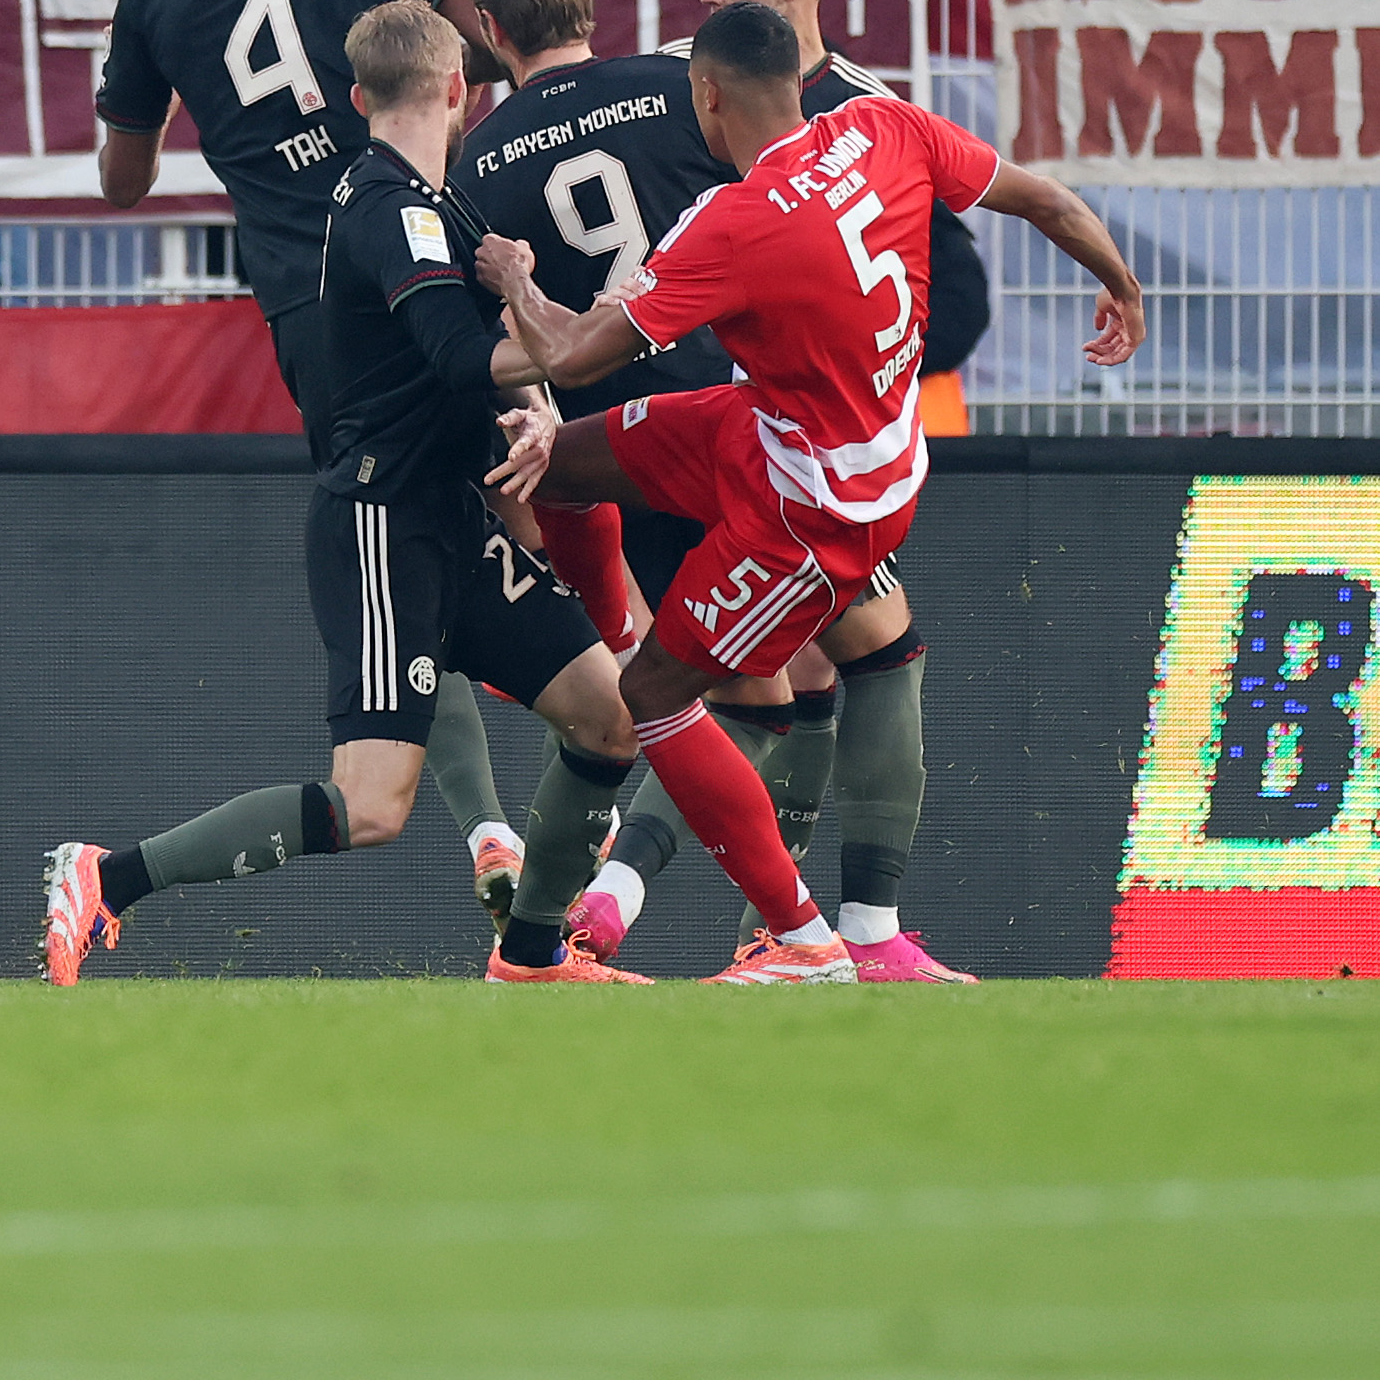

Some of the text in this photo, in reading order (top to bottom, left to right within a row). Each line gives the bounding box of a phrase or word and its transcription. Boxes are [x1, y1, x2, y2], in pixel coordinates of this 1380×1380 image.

[541, 80, 577, 99] FCBM
[1011, 24, 1380, 162] IMM
[274, 124, 339, 173] TAH
[476, 94, 668, 179] FC BAYERN MÜNCHEN
[767, 187, 799, 215] 1.
[788, 170, 828, 202] FC
[814, 126, 874, 179] UNION
[543, 148, 651, 299] 9
[823, 169, 868, 211] BERLIN
[835, 189, 913, 354] 5
[710, 556, 772, 612] 5
